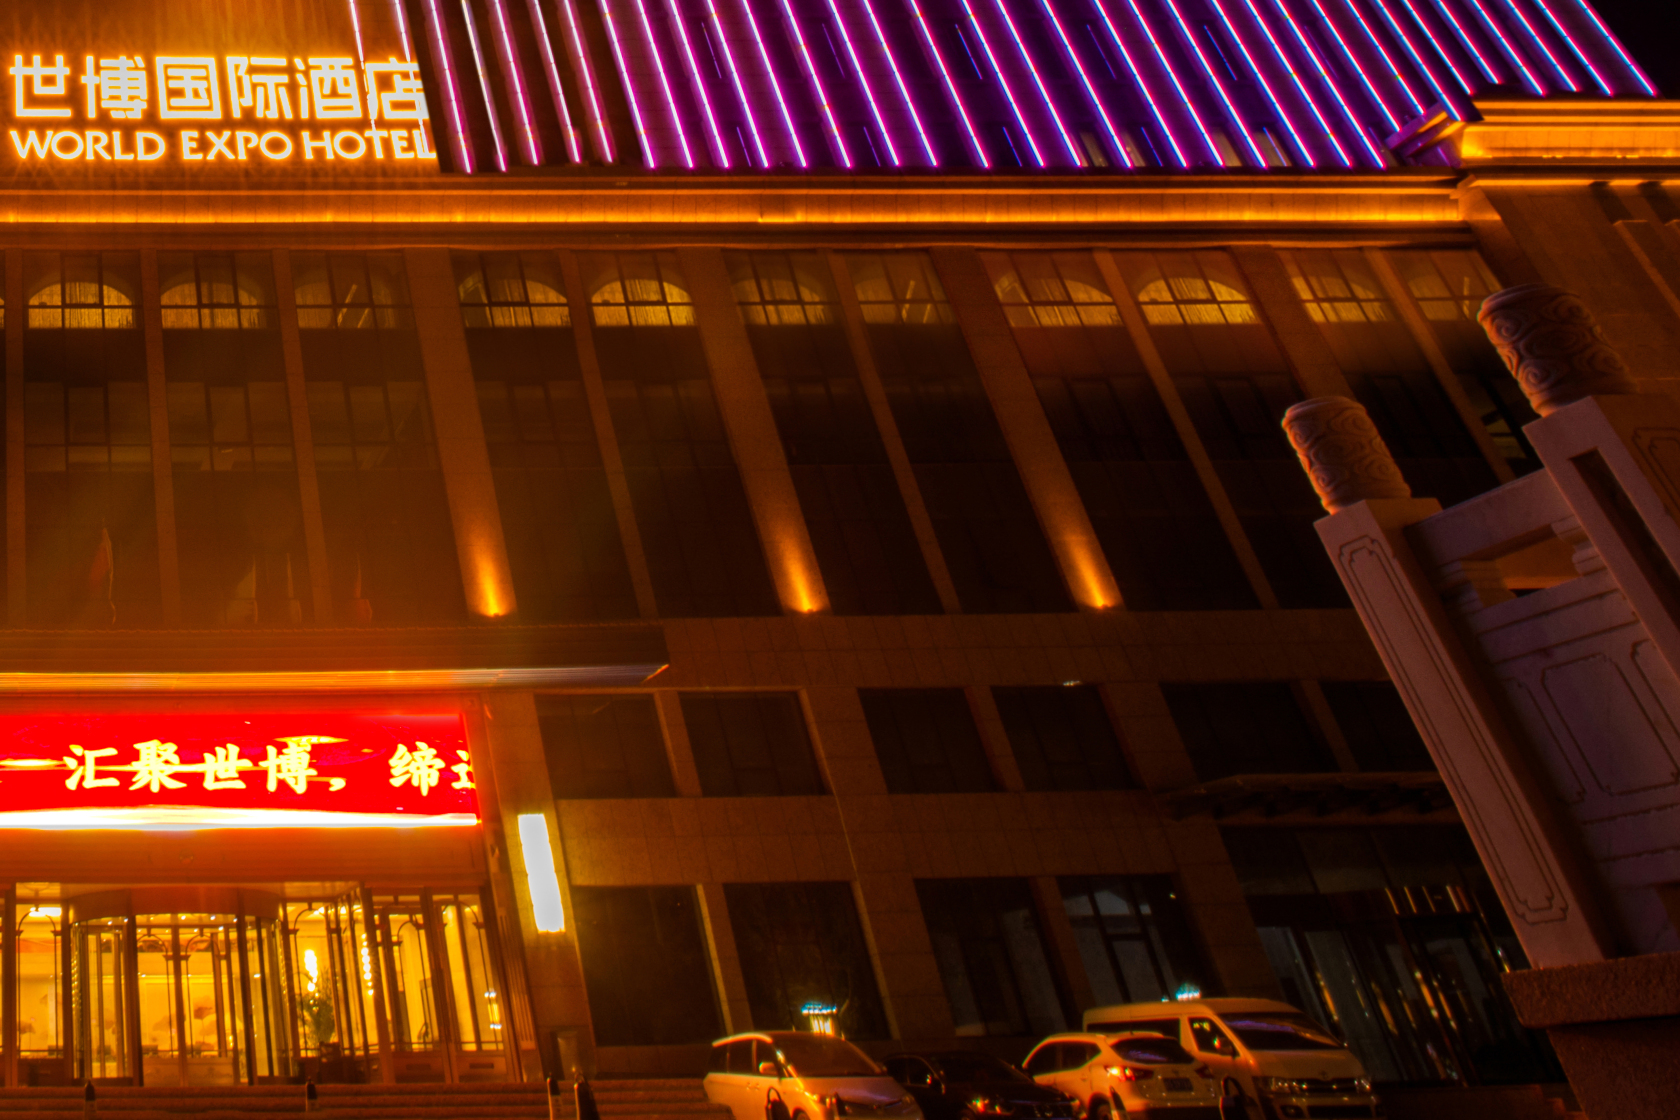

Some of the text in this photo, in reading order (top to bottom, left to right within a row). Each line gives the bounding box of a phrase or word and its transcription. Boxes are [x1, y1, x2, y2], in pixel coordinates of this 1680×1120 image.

[9, 54, 429, 119] 世博国际酒店
[9, 129, 437, 161] WORLD EXPO HOTEL
